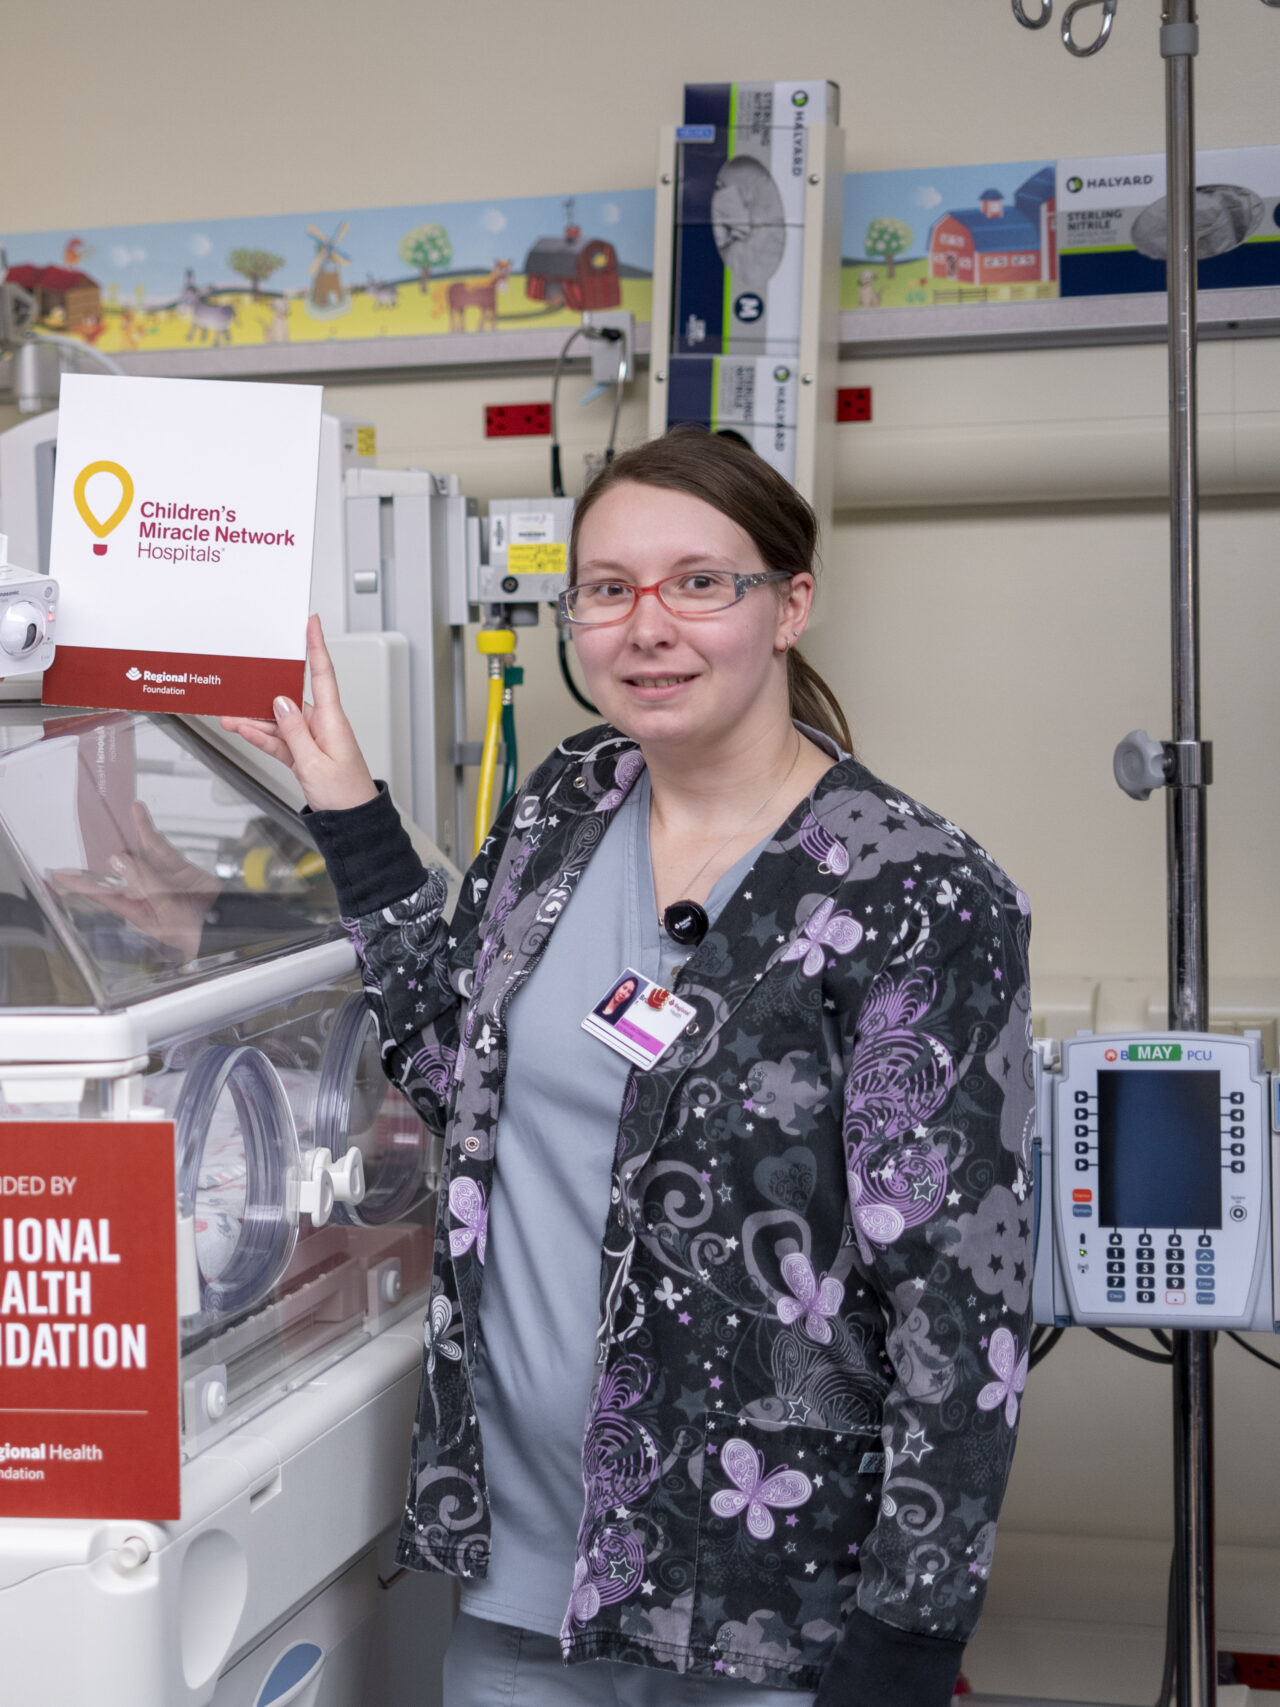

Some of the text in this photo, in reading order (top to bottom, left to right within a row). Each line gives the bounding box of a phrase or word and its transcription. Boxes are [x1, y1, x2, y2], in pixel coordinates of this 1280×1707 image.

[792, 111, 805, 177] HALYARD
[1086, 174, 1153, 189] HALYARD
[1067, 208, 1123, 221] STERLING
[1067, 219, 1111, 231] NITRILE
[739, 298, 760, 319] M
[774, 386, 786, 452] HALYARD
[140, 501, 237, 523] Children's
[139, 521, 295, 547] Miracle Network
[137, 541, 221, 565] Hospitals
[143, 669, 222, 686] Regional Health
[142, 684, 186, 696] Foundation
[1138, 1046, 1173, 1060] MAY
[1187, 1050, 1213, 1061] PCU
[51, 1175, 77, 1195] BY
[49, 1443, 103, 1461] Health
